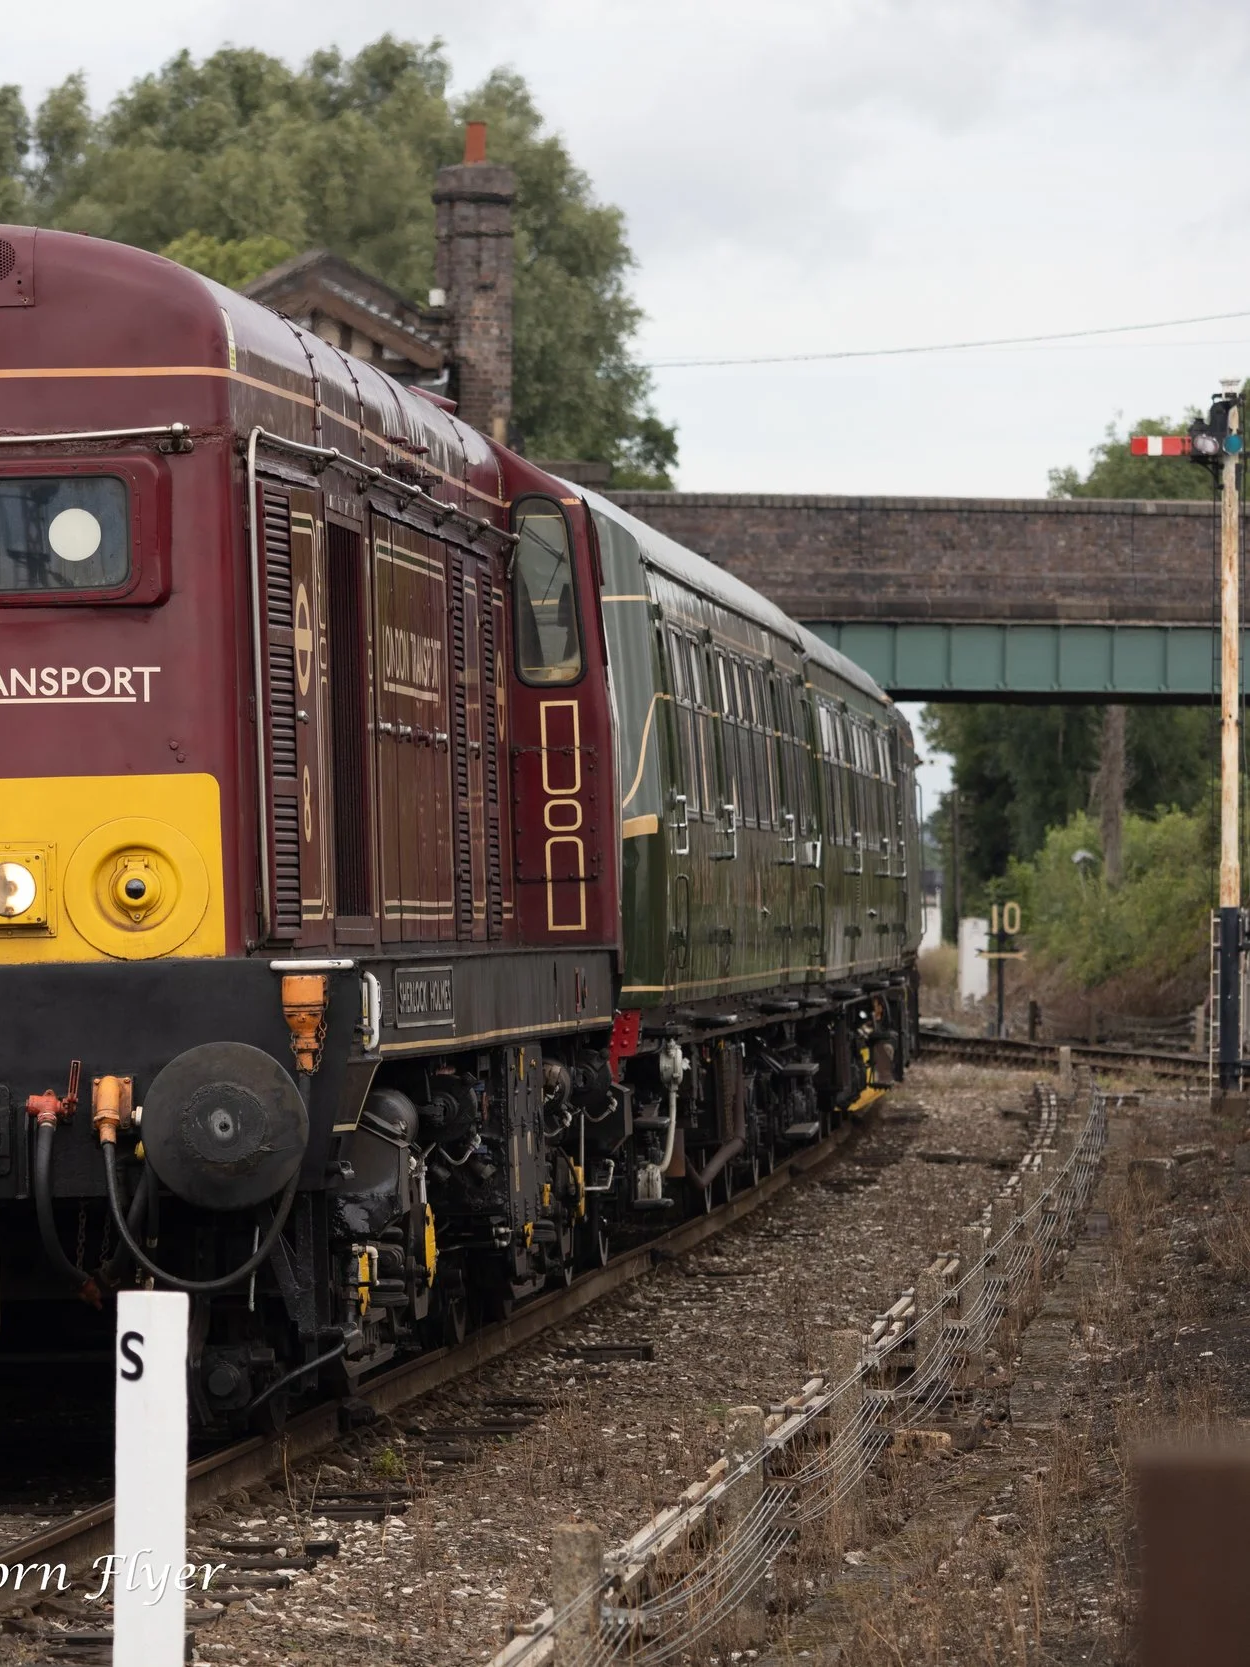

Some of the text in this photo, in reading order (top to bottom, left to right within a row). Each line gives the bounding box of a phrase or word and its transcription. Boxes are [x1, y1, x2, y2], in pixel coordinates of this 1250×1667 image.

[382, 625, 410, 691] LONDON
[303, 764, 312, 843] 8
[991, 901, 1021, 935] 10
[399, 981, 428, 1014] SHERLOCK
[430, 979, 451, 1012] HOLMES
[120, 1331, 144, 1382] S
